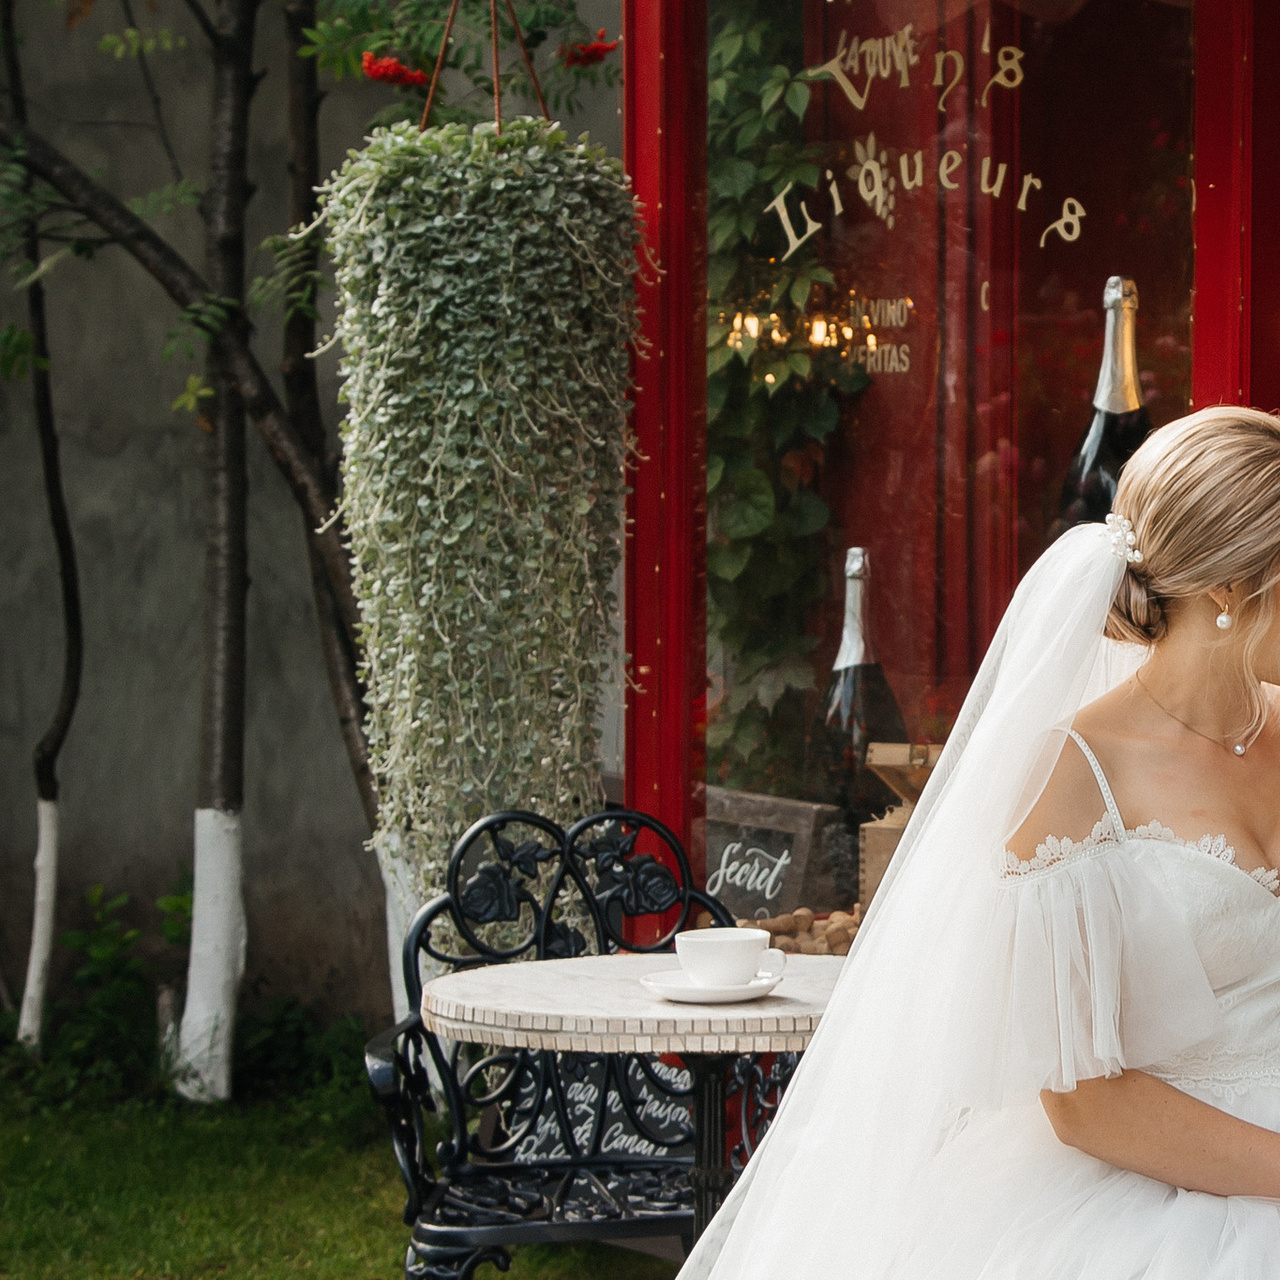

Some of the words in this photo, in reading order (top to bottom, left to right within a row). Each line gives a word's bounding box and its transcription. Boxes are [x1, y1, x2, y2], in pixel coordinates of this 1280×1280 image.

[763, 149, 1086, 263] Liqueurs
[870, 297, 908, 328] VINO
[705, 841, 792, 900] Secret
